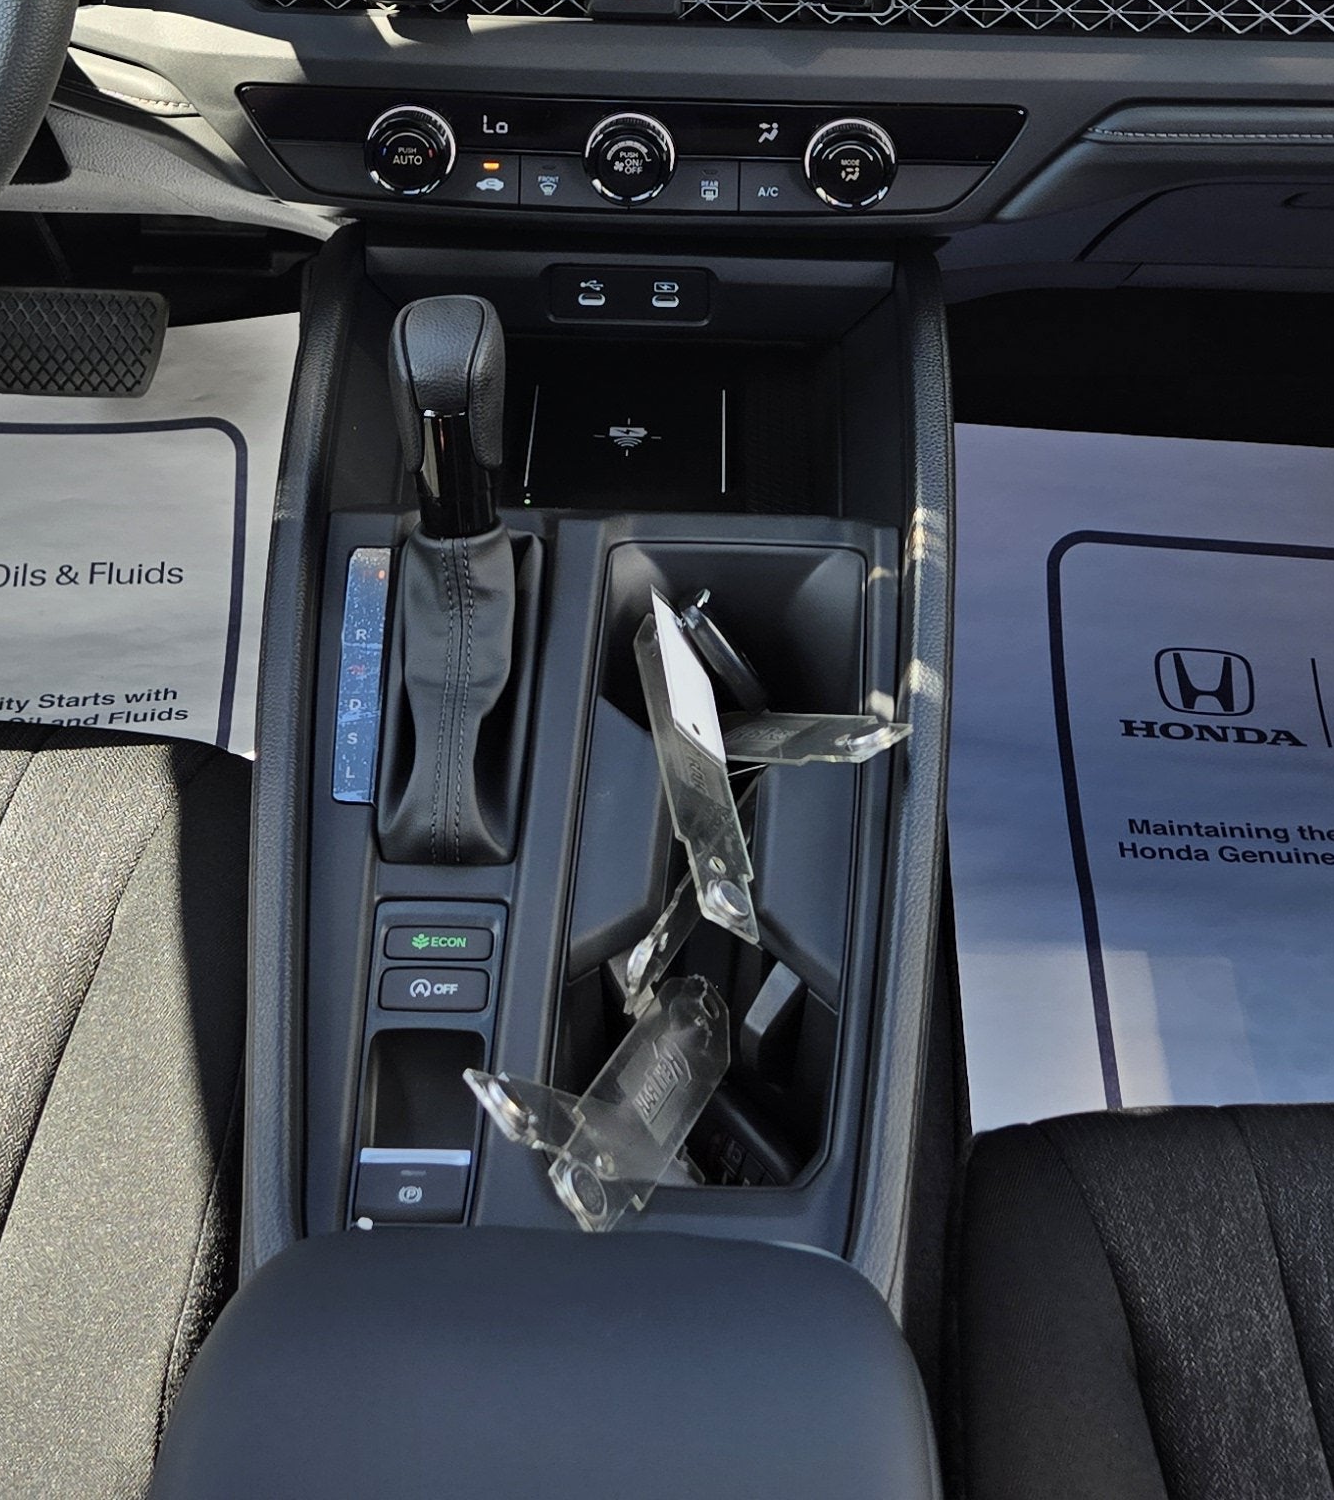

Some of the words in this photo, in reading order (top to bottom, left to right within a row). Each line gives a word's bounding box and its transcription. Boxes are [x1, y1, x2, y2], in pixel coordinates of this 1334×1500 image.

[483, 114, 508, 134] Lo
[393, 156, 422, 165] AUTO
[620, 151, 638, 159] PUSH
[624, 159, 643, 167] ON/
[841, 159, 860, 167] MODE
[624, 167, 643, 175] OFF
[757, 187, 779, 197] A/C
[55, 563, 80, 586] &
[88, 561, 184, 585] Fluids
[356, 629, 367, 641] R
[38, 692, 115, 708] Starts
[125, 687, 178, 703] with
[349, 699, 362, 711] D
[51, 714, 99, 726] and
[108, 707, 189, 724] Fluids
[347, 732, 358, 745] S
[1120, 718, 1307, 748] HONDA
[345, 767, 355, 779] L
[1128, 818, 1290, 844] Maintaining
[1118, 841, 1210, 862] Honda
[431, 937, 467, 948] ECON
[433, 984, 458, 995] OFF
